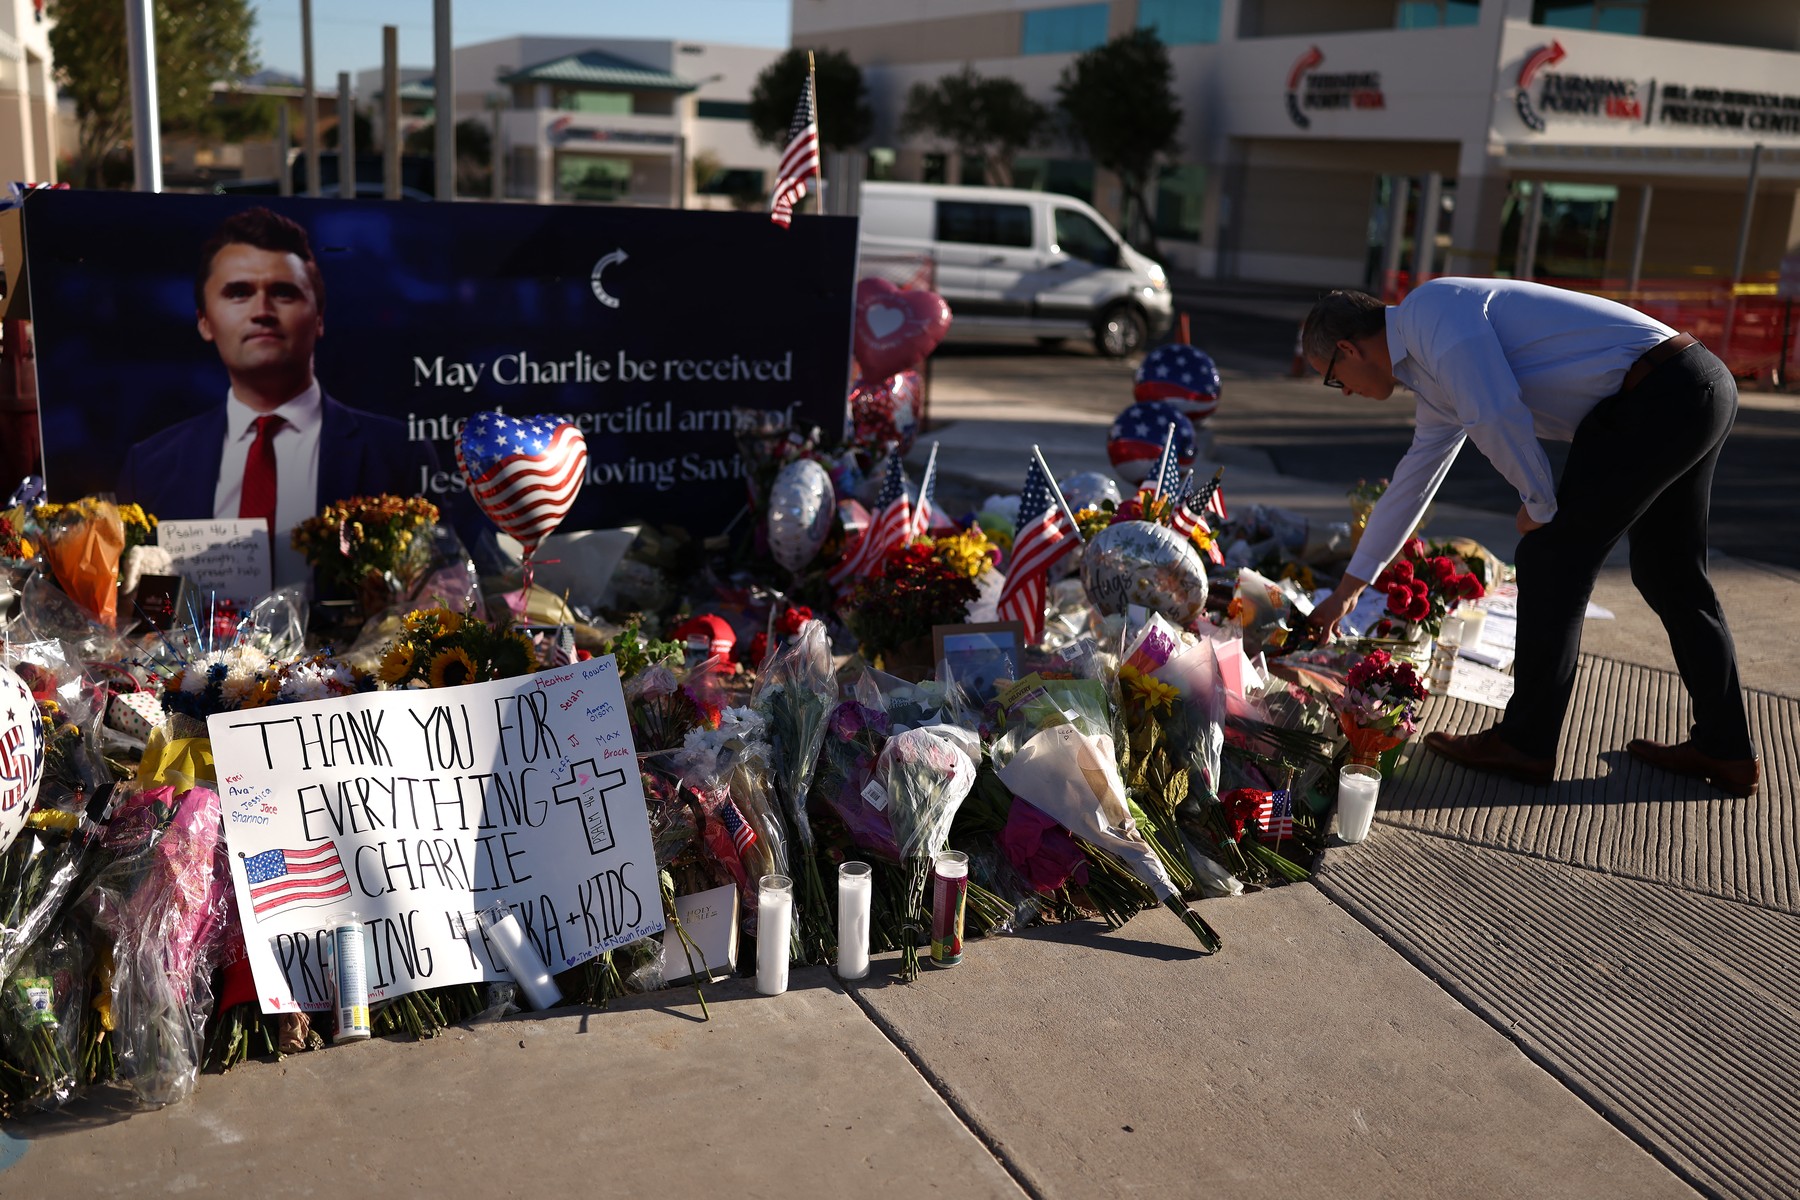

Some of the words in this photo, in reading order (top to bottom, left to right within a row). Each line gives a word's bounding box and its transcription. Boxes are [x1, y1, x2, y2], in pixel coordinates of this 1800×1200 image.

[413, 355, 486, 393] May
[492, 351, 610, 386] Charlie
[618, 350, 657, 382] be
[664, 351, 792, 382] received
[563, 401, 672, 434] erciful
[414, 465, 468, 498] Jes
[1089, 568, 1133, 603] Hugs
[535, 672, 575, 690] Heather
[586, 702, 609, 716] Aaron
[589, 705, 614, 722] Olson
[229, 708, 394, 770] THANK
[409, 704, 475, 770] YOU
[495, 690, 562, 766] FOR
[595, 730, 620, 747] Max
[603, 747, 629, 760] Brock
[551, 755, 571, 780] Jeff
[229, 786, 250, 796] Ava
[240, 788, 272, 810] Jessica
[297, 768, 548, 842] EVERYTHING
[231, 811, 269, 826] Shannon
[588, 811, 607, 844] PSALM
[355, 832, 533, 899] CHARLIE
[635, 920, 662, 937] Family
[276, 910, 433, 1003] PRAING
[367, 988, 385, 998] mily
